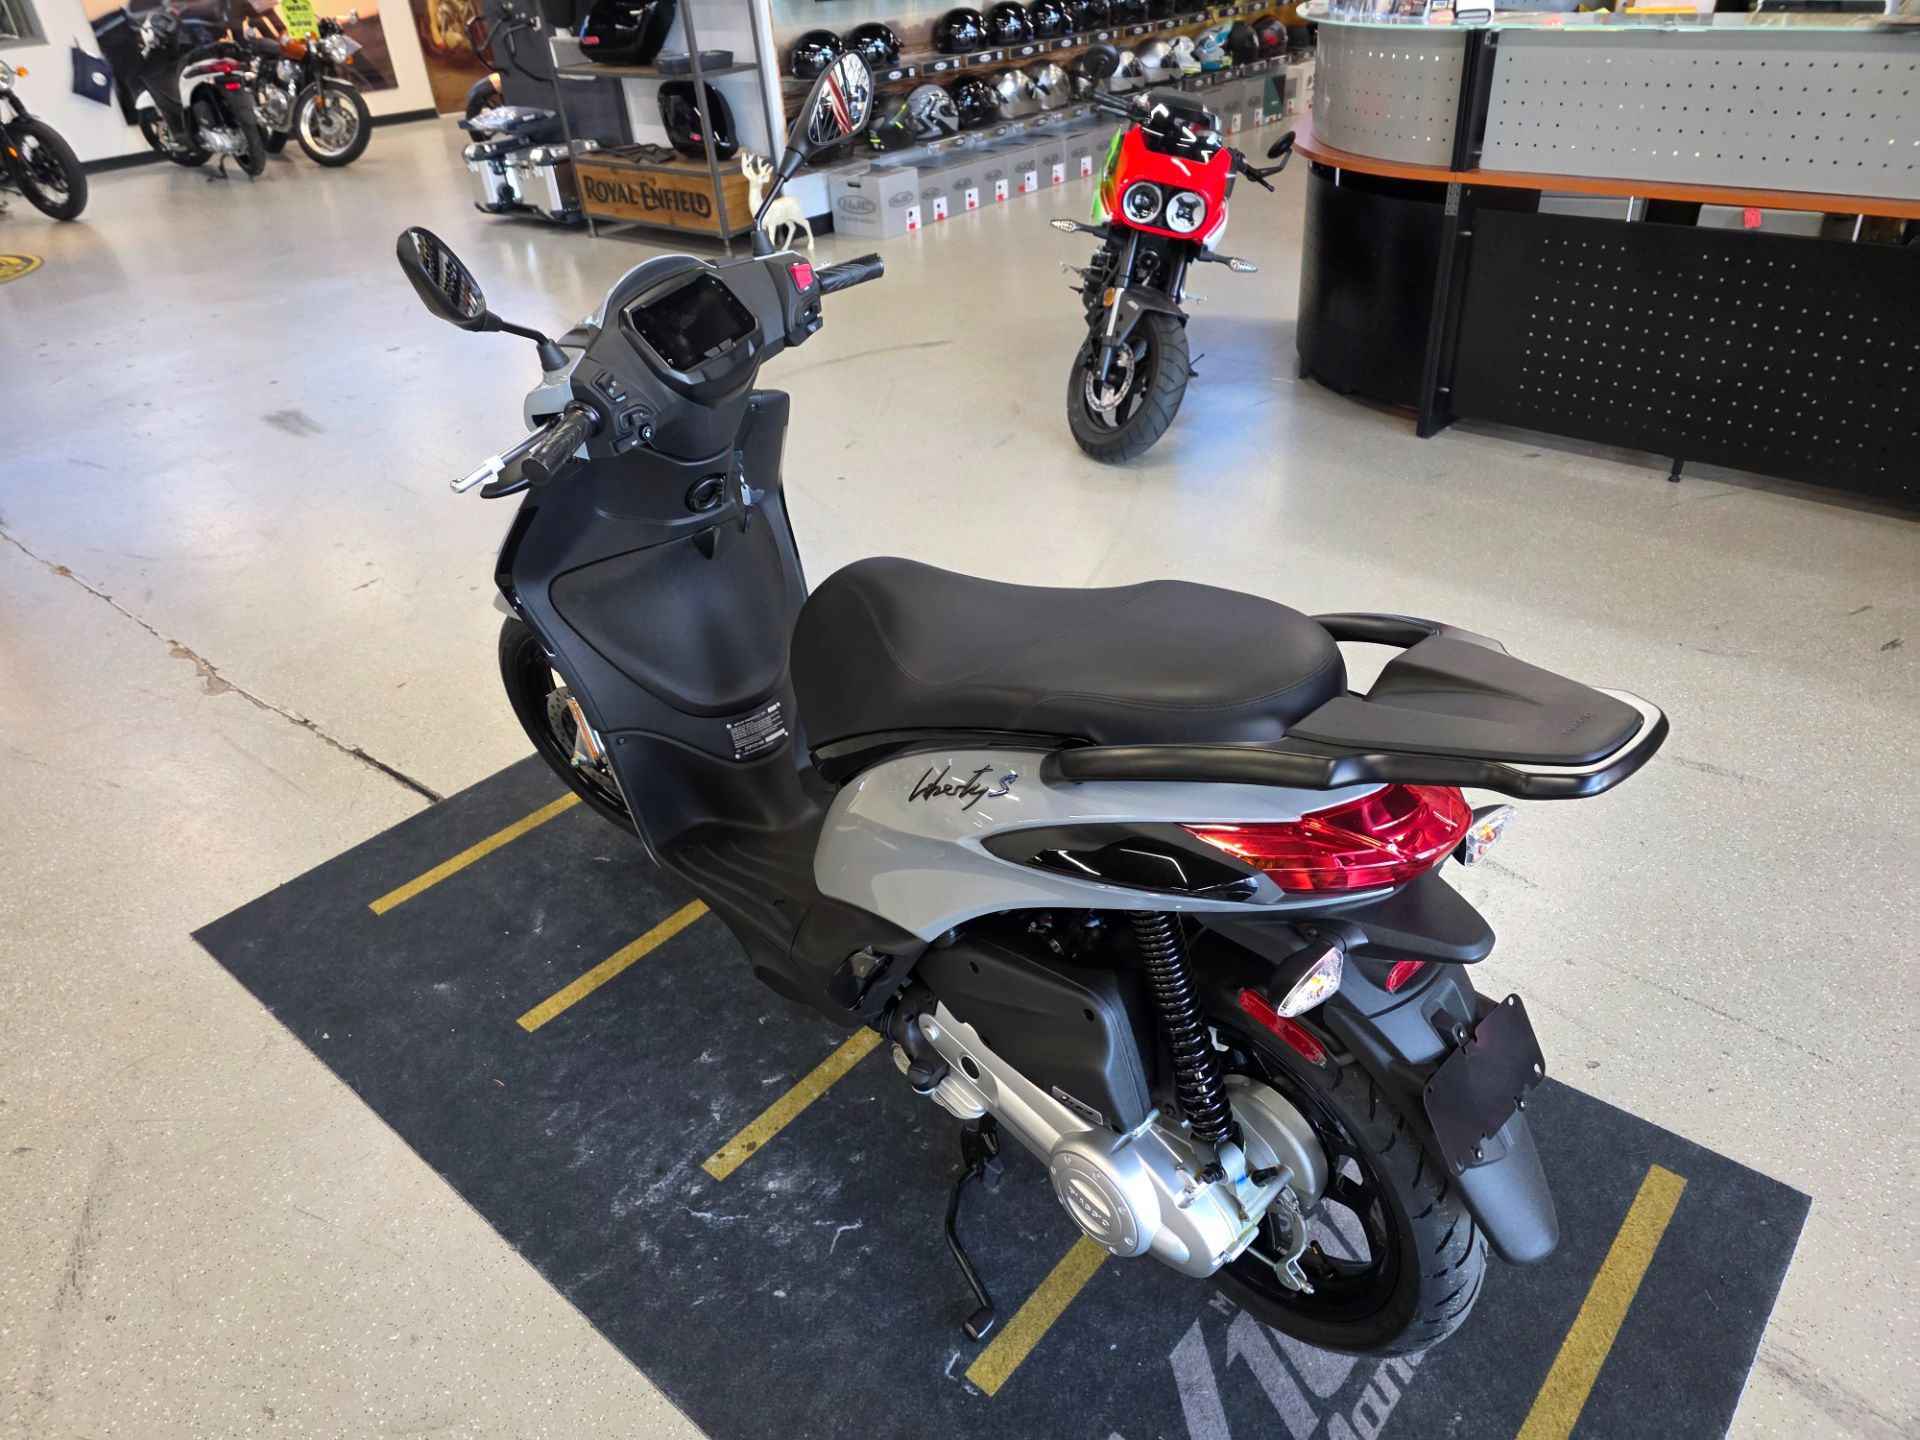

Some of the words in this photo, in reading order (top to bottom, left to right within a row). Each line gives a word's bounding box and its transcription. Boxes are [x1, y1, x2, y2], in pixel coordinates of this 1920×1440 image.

[582, 175, 638, 206] ROYAL
[638, 180, 713, 220] ENFIELD
[908, 764, 994, 811] Liberty
[987, 774, 1019, 798] S
